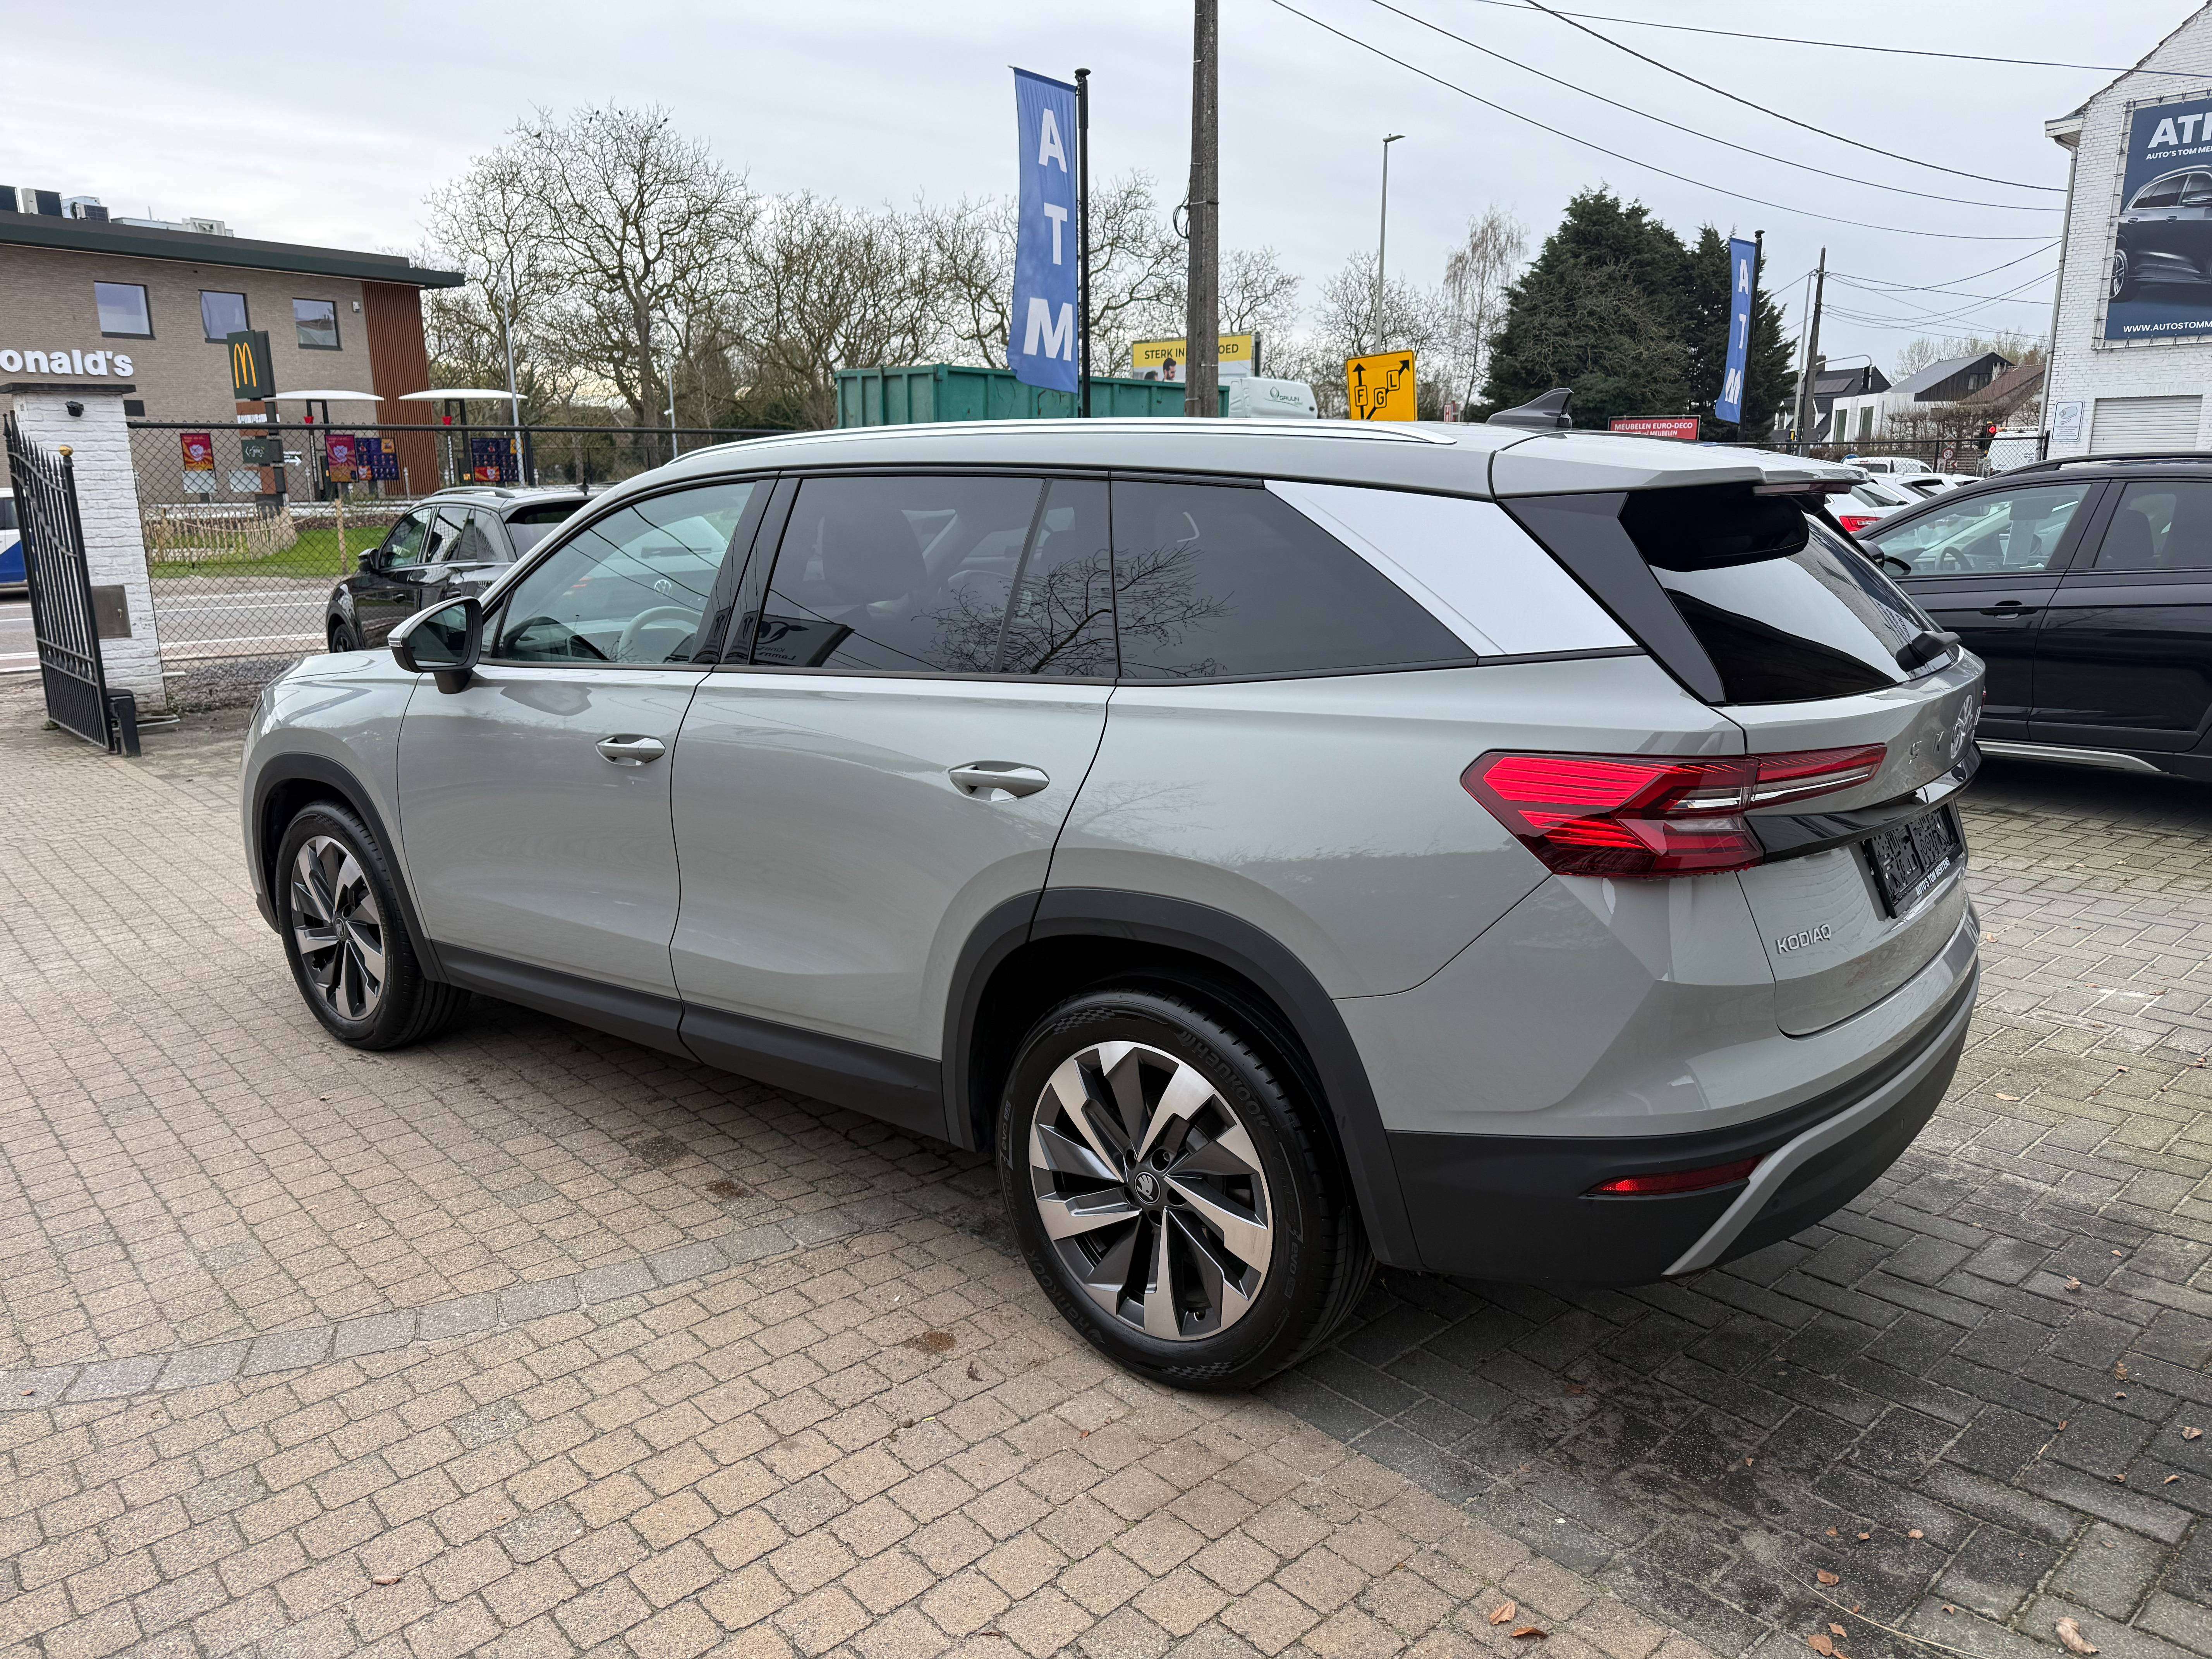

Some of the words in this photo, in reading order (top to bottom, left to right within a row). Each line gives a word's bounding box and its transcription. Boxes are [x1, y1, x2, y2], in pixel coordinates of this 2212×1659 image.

[2178, 148, 2197, 156] TOM
[1023, 108, 1073, 362] ATM
[1725, 259, 1749, 405] ATM
[1144, 348, 1173, 359] STERK
[1175, 348, 1185, 357] IN
[1390, 374, 1397, 388] L
[1357, 388, 1364, 403] F
[1377, 391, 1384, 405] G
[1927, 868, 1937, 884] TOM
[1776, 923, 1832, 954] KODIAQ
